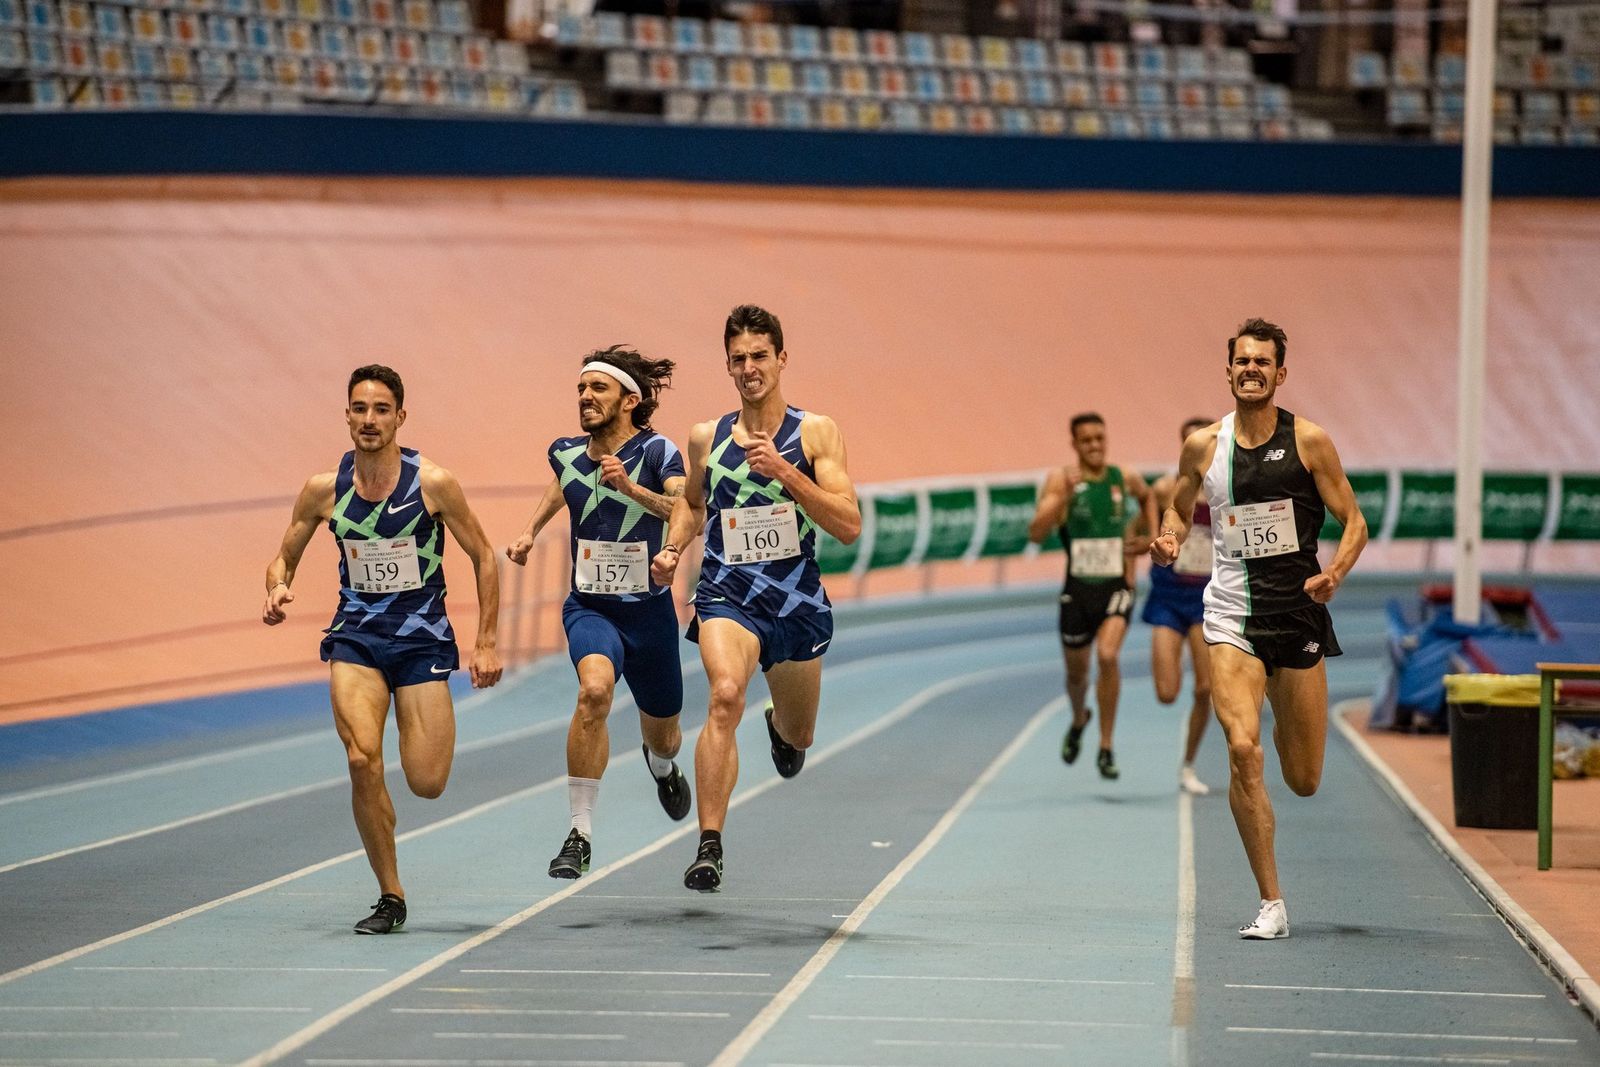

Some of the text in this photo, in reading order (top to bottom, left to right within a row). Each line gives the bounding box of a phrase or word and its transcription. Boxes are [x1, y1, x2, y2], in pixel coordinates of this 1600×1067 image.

[742, 529, 780, 550] 160
[1242, 525, 1278, 546] 156
[363, 562, 398, 582] 159
[595, 564, 630, 582] 157
